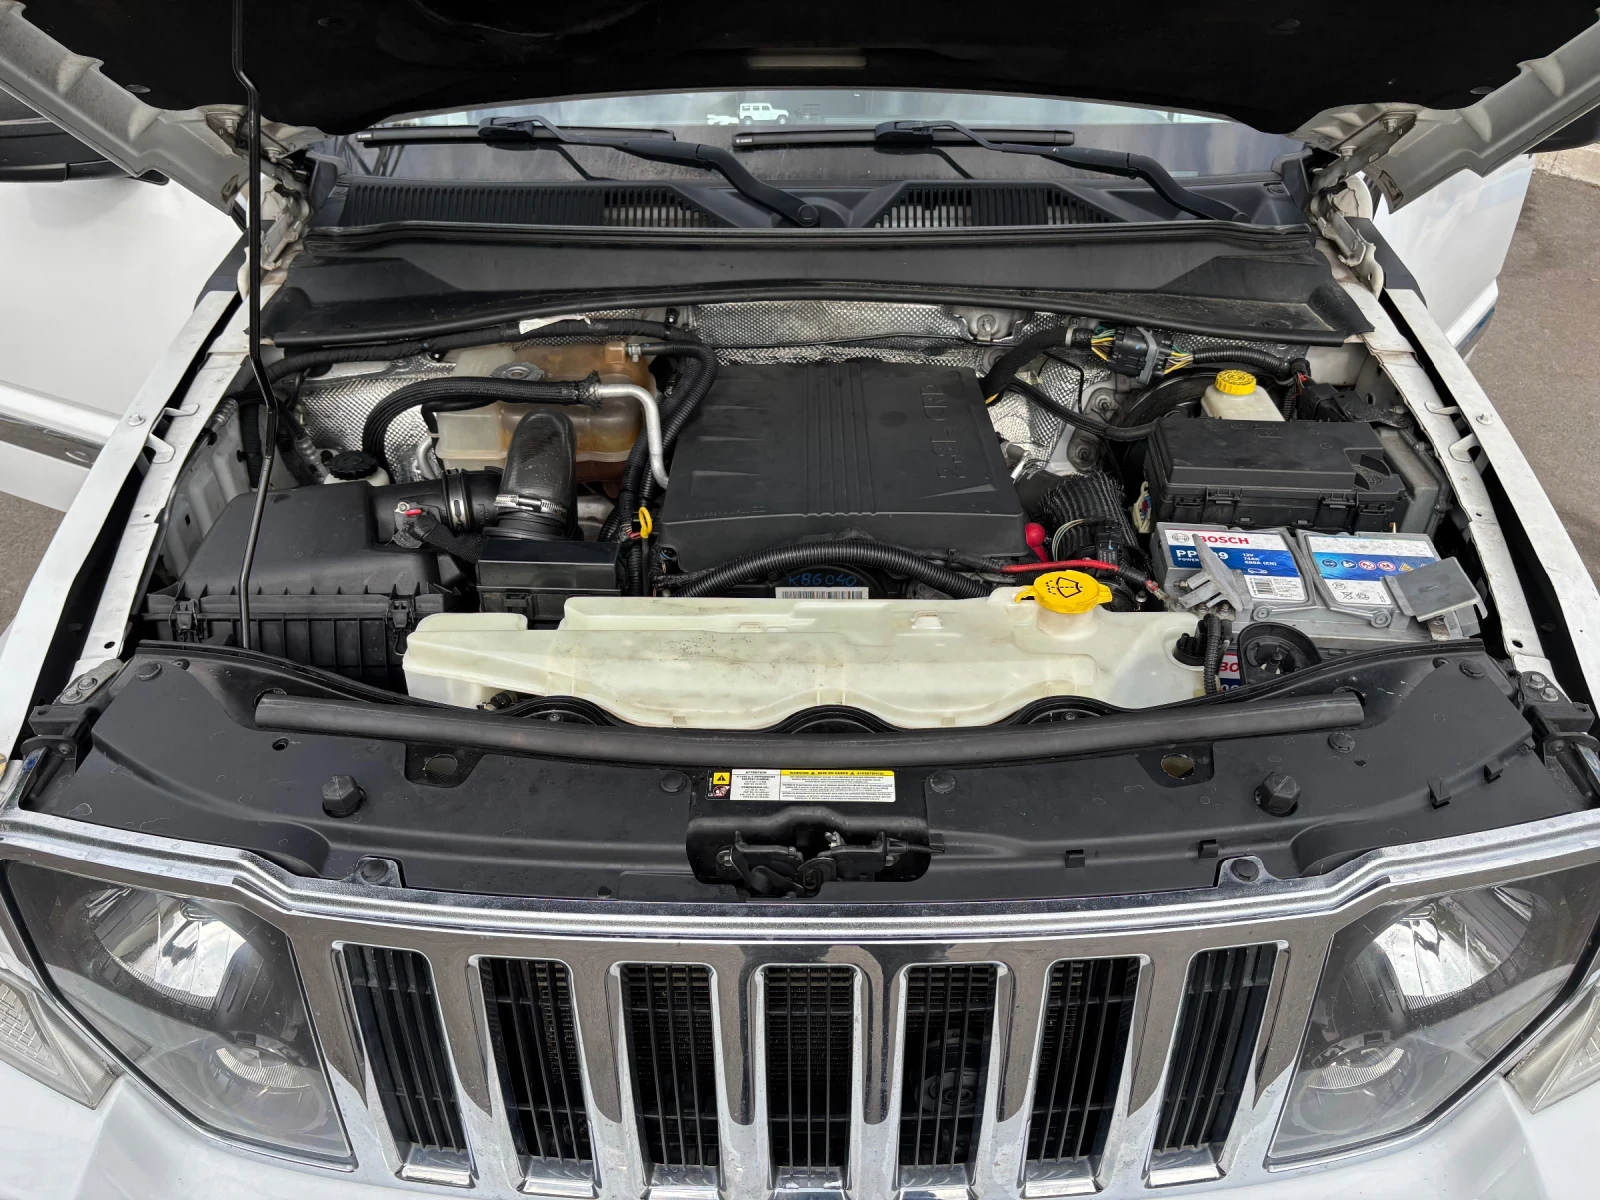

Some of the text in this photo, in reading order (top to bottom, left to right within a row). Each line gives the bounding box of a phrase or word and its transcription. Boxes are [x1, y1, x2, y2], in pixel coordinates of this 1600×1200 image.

[920, 384, 952, 421] CRD
[1200, 535, 1250, 545] BOSCH
[1176, 549, 1229, 560] PP9
[788, 572, 857, 587] K86040
